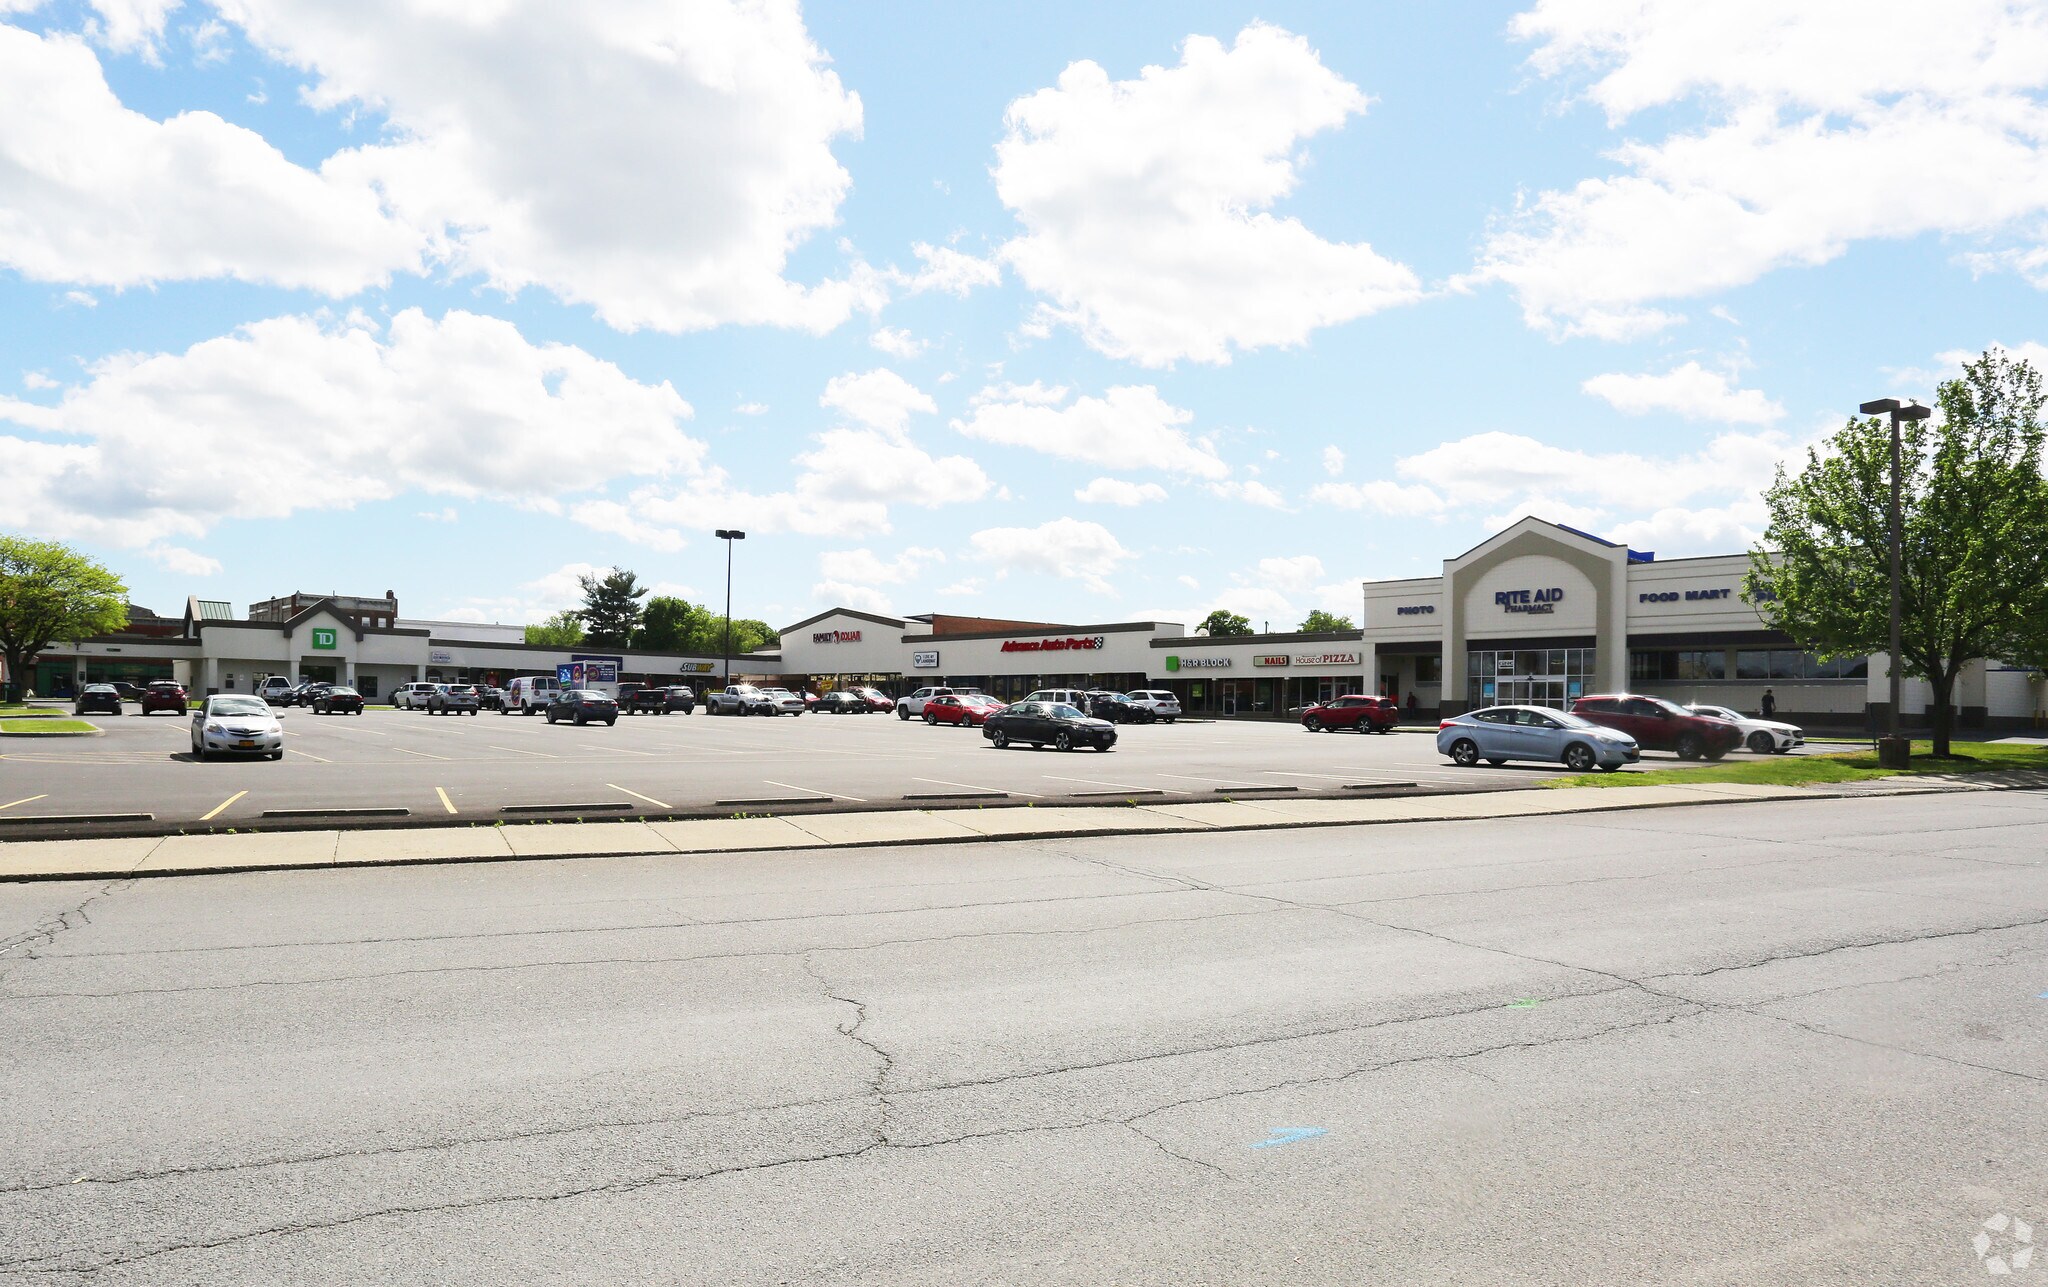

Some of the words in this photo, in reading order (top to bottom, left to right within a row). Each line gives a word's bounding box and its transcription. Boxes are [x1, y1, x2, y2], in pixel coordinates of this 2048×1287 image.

[1495, 589, 1530, 605] RITE
[1534, 587, 1563, 602] AID
[1639, 592, 1680, 603] FOOD
[1685, 588, 1731, 601] MART
[1397, 605, 1435, 615] PHOTO
[1504, 603, 1554, 613] PHARMACY
[315, 632, 334, 645] TD
[813, 632, 832, 643] FAMILY
[840, 630, 862, 642] DOLLAR
[1001, 640, 1041, 652] Advance
[1041, 638, 1066, 651] Auto
[1065, 637, 1095, 650] Parts
[1181, 659, 1200, 667] H&R
[1200, 658, 1231, 667] BLOCK
[1264, 656, 1286, 665] NAILS
[1322, 654, 1355, 663] PIZZA
[680, 662, 715, 673] SUBWAY
